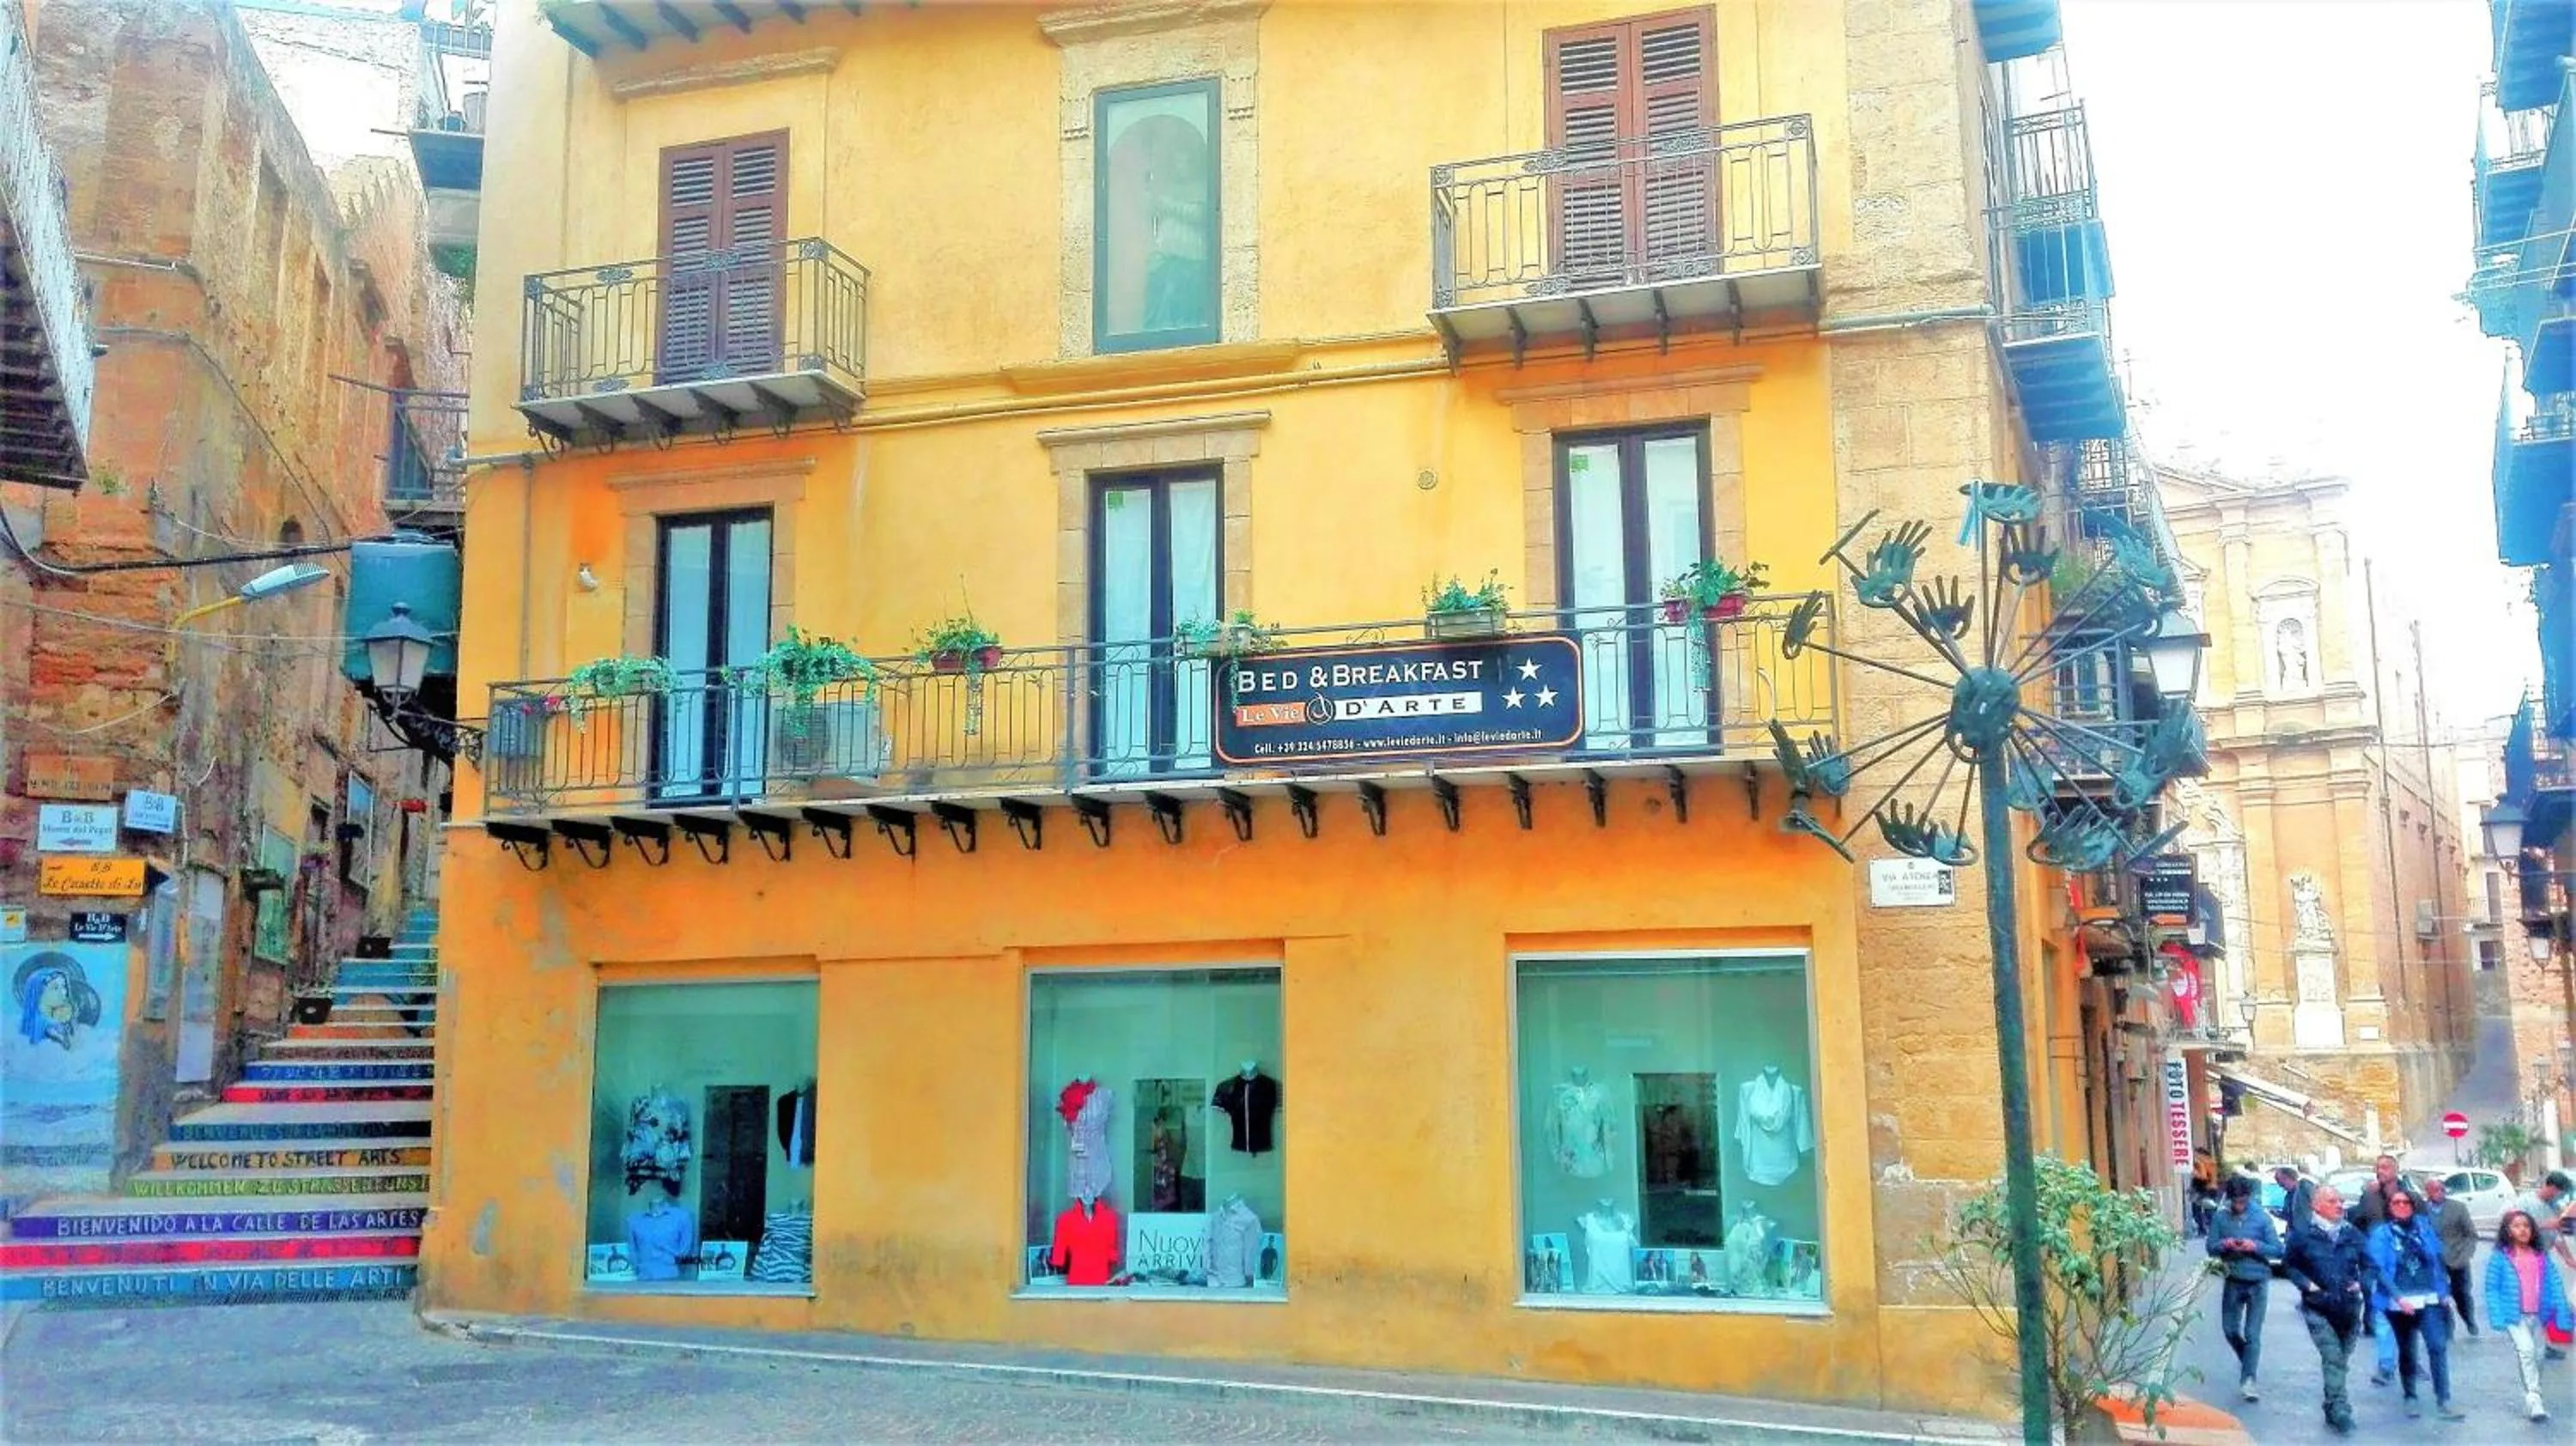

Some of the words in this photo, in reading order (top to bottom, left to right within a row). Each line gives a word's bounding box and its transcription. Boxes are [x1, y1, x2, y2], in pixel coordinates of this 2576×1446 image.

[1242, 708, 1265, 722] Le
[1271, 706, 1299, 720] Vie
[2166, 1060, 2185, 1099] FOTO
[2170, 1102, 2190, 1166] TESSERE
[58, 1215, 176, 1236] BIENVENIDO
[201, 1215, 223, 1232] LA
[232, 1214, 287, 1230] CALLE
[301, 1213, 321, 1230] DE
[329, 1212, 360, 1230] LAS
[365, 1210, 419, 1229] ARTES
[44, 1274, 174, 1297] BENVENUTI
[226, 1273, 263, 1289] VIA
[274, 1270, 334, 1289] DELLE
[349, 1267, 401, 1286] ARTI
